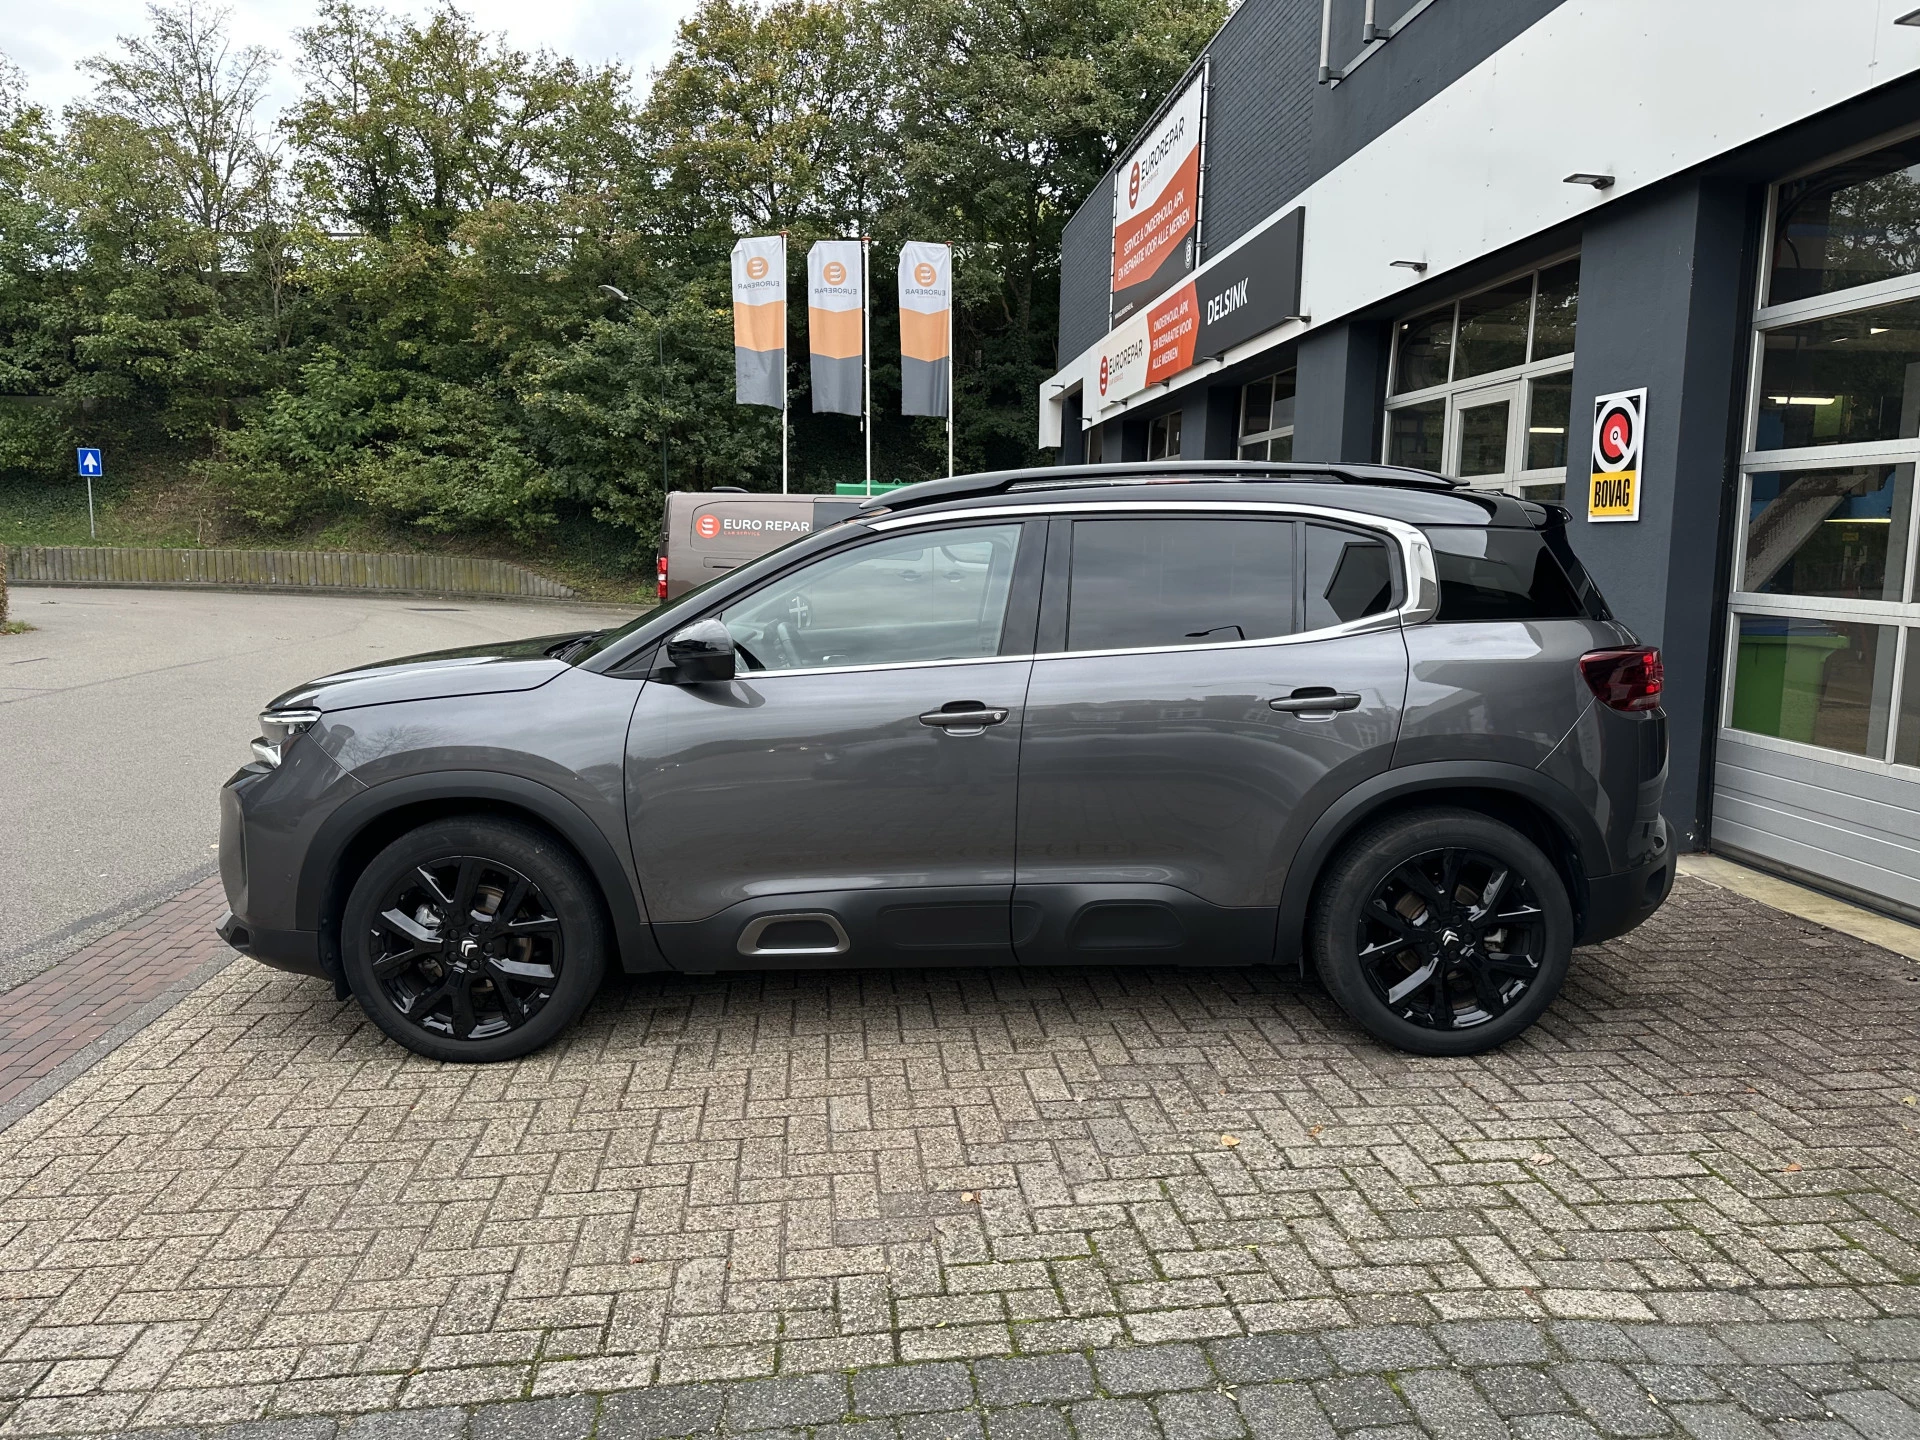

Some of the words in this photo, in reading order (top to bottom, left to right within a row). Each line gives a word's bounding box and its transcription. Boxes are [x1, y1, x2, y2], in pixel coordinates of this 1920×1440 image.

[1141, 116, 1184, 181] EUROREPAR
[1123, 230, 1140, 257] SERVICE
[1144, 200, 1173, 238] ONDERHOUD,
[1173, 188, 1184, 208] APK
[1117, 266, 1124, 282] EN
[1123, 247, 1145, 277] REPARATIE
[1144, 235, 1158, 258] VOOR
[1157, 225, 1169, 246] ALLE
[1169, 205, 1190, 236] MERKEN
[1179, 299, 1189, 316] APK
[1207, 277, 1248, 325] DELSINK
[1152, 339, 1158, 352] EN
[1179, 318, 1193, 337] VOOR
[1109, 339, 1143, 375] EUROREPAR
[1152, 355, 1162, 371] ALLE
[1161, 346, 1179, 366] MERKEN
[1594, 478, 1631, 508] BOVAG
[723, 518, 763, 530] EURO
[765, 520, 810, 532] REPAR
